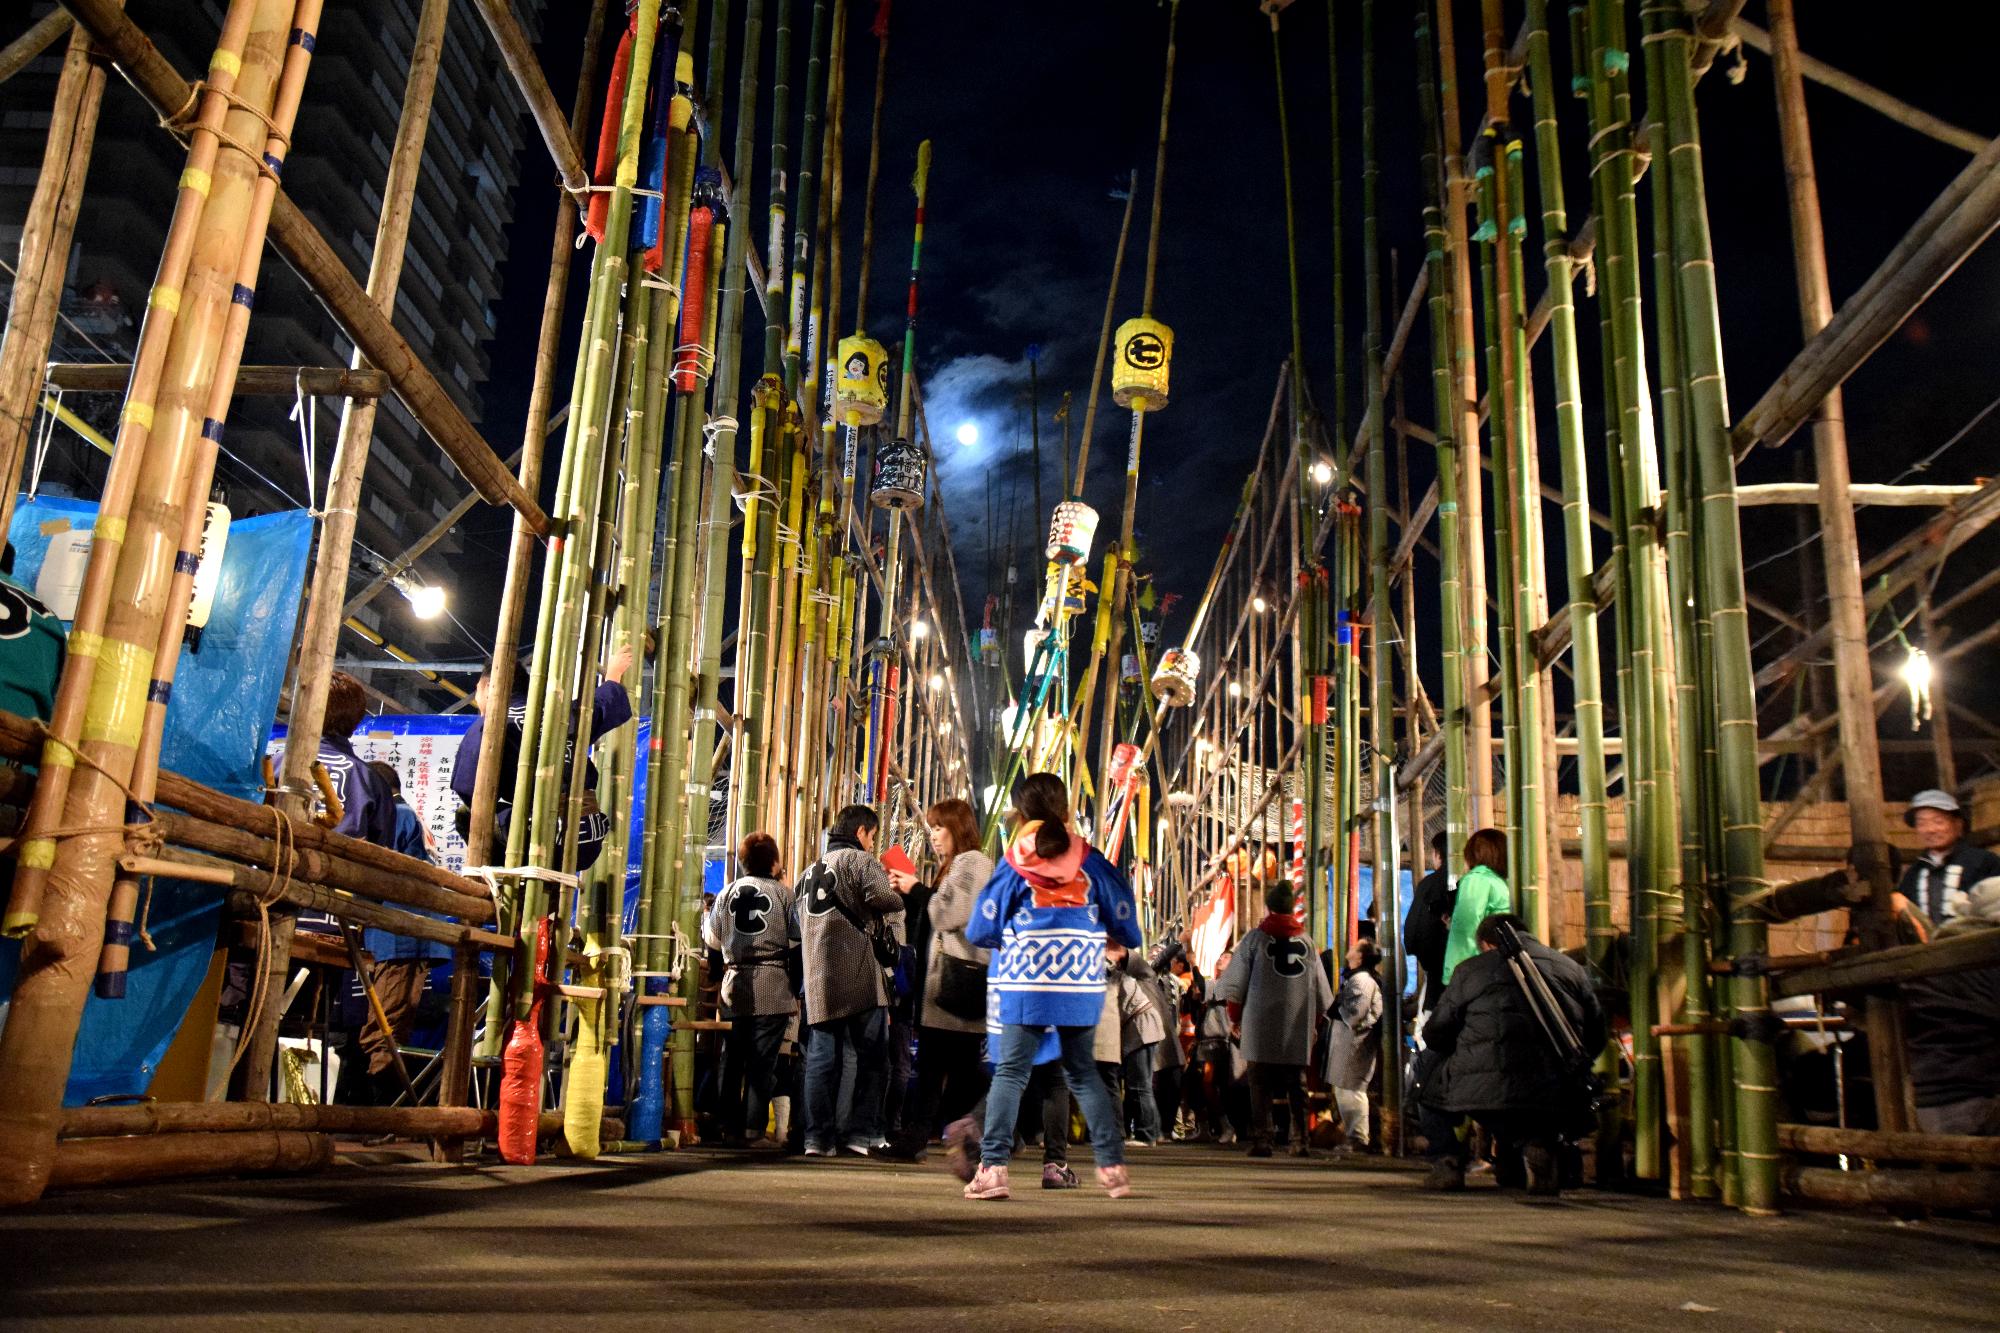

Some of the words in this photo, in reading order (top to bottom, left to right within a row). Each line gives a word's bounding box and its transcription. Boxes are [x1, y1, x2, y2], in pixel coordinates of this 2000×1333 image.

[896, 446, 915, 488] 八幡町
[729, 884, 773, 936] 七
[1266, 937, 1310, 978] 七
